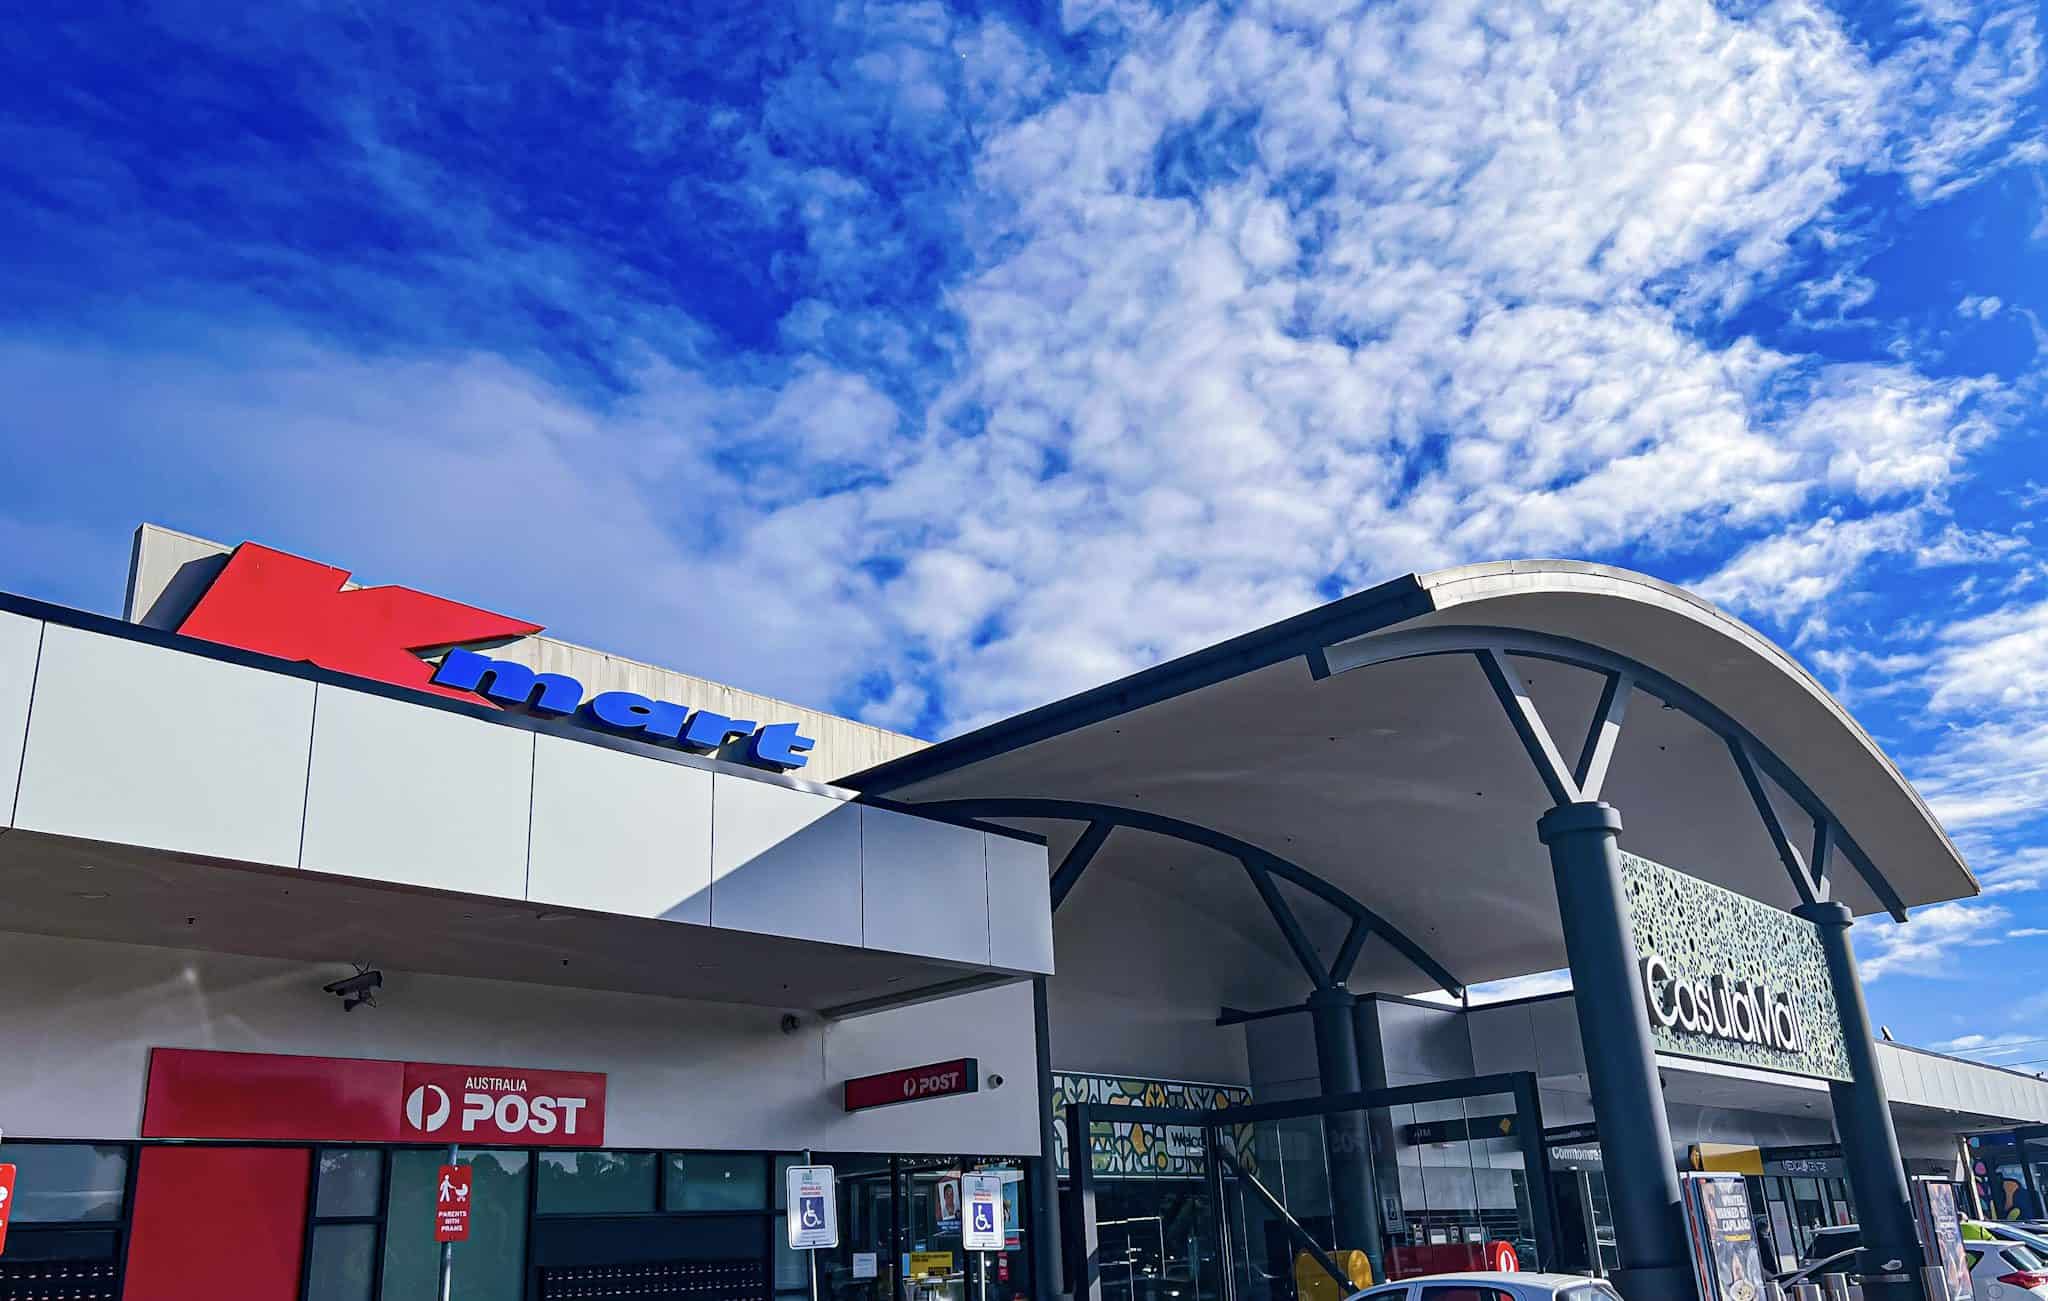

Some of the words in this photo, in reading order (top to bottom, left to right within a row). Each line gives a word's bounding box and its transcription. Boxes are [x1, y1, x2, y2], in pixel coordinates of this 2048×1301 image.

[465, 1076, 528, 1092] AUSTRALIA
[919, 1071, 960, 1094] POST
[462, 1092, 587, 1135] POST
[438, 1210, 468, 1218] PARENTS
[441, 1225, 464, 1233] PRAMS
